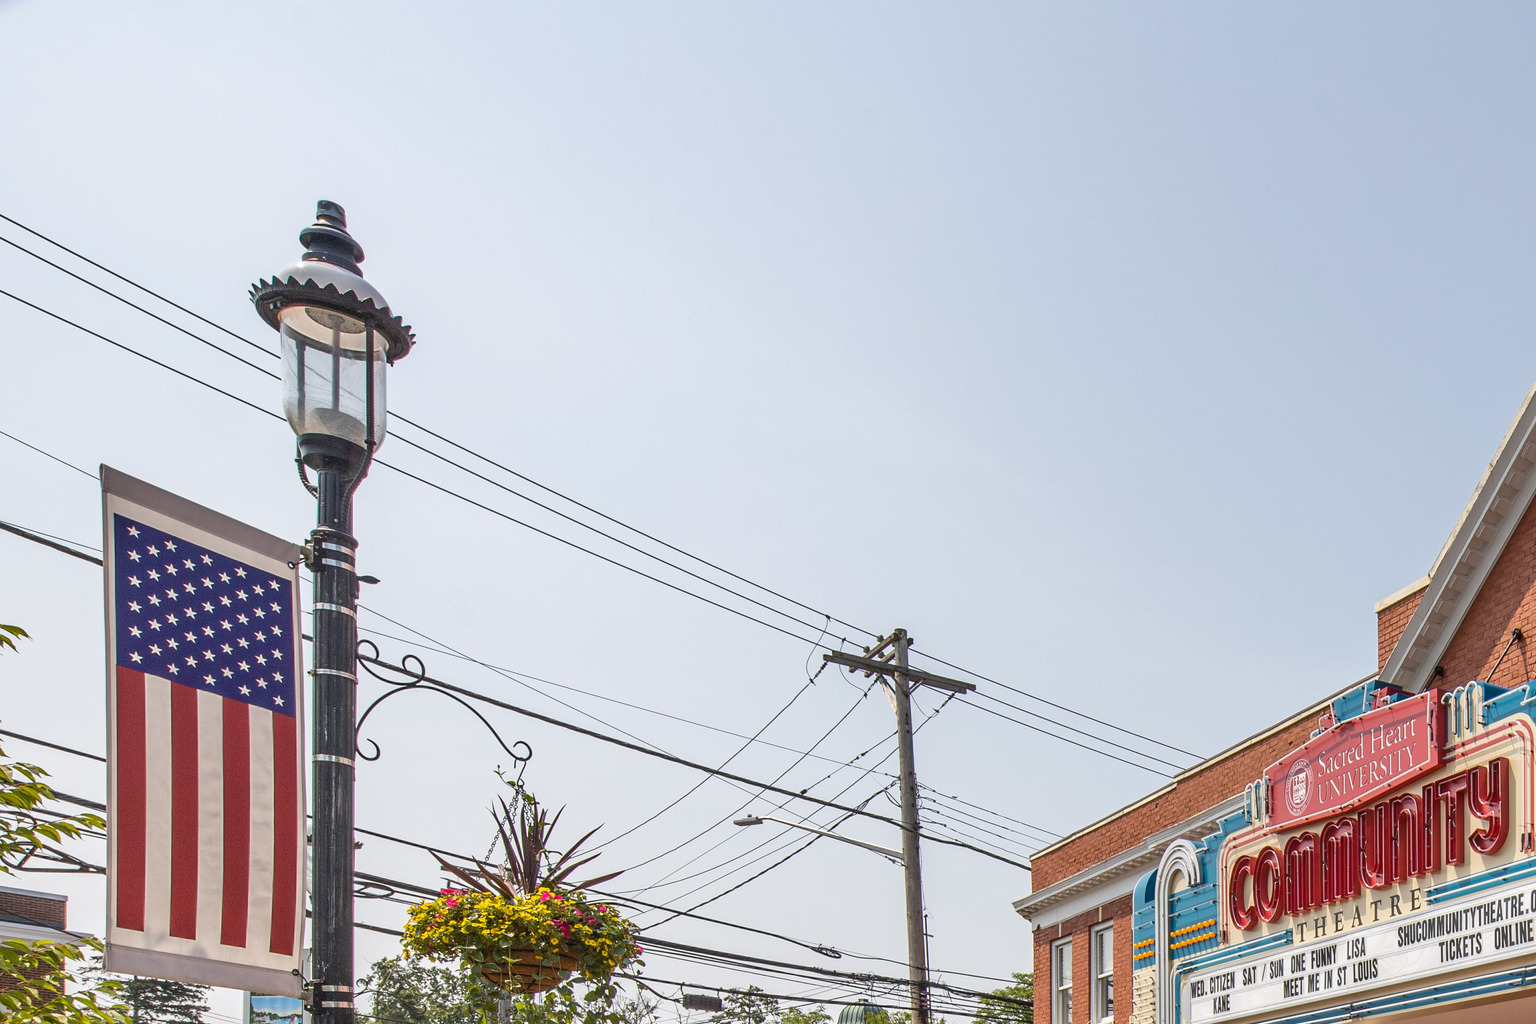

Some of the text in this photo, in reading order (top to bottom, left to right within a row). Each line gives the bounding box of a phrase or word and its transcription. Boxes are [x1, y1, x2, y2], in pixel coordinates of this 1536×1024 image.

[1318, 716, 1417, 778] Sacred Heart
[1318, 743, 1417, 804] UNIVERSITY
[1229, 757, 1510, 932] COMMUNITY
[1297, 888, 1422, 943] THEATRE
[1439, 919, 1534, 963] TICKETS ONLINE
[1190, 981, 1208, 998] WED.
[1210, 971, 1235, 994] CITIZEN
[1242, 966, 1257, 986] SAT
[1269, 958, 1284, 979] SUN
[1291, 953, 1306, 974] ONE
[1311, 945, 1337, 969] FUNNY
[1347, 937, 1366, 960] LISA
[1283, 958, 1378, 998] MEET ME IN ST LOUIS
[1213, 994, 1230, 1015] KANE
